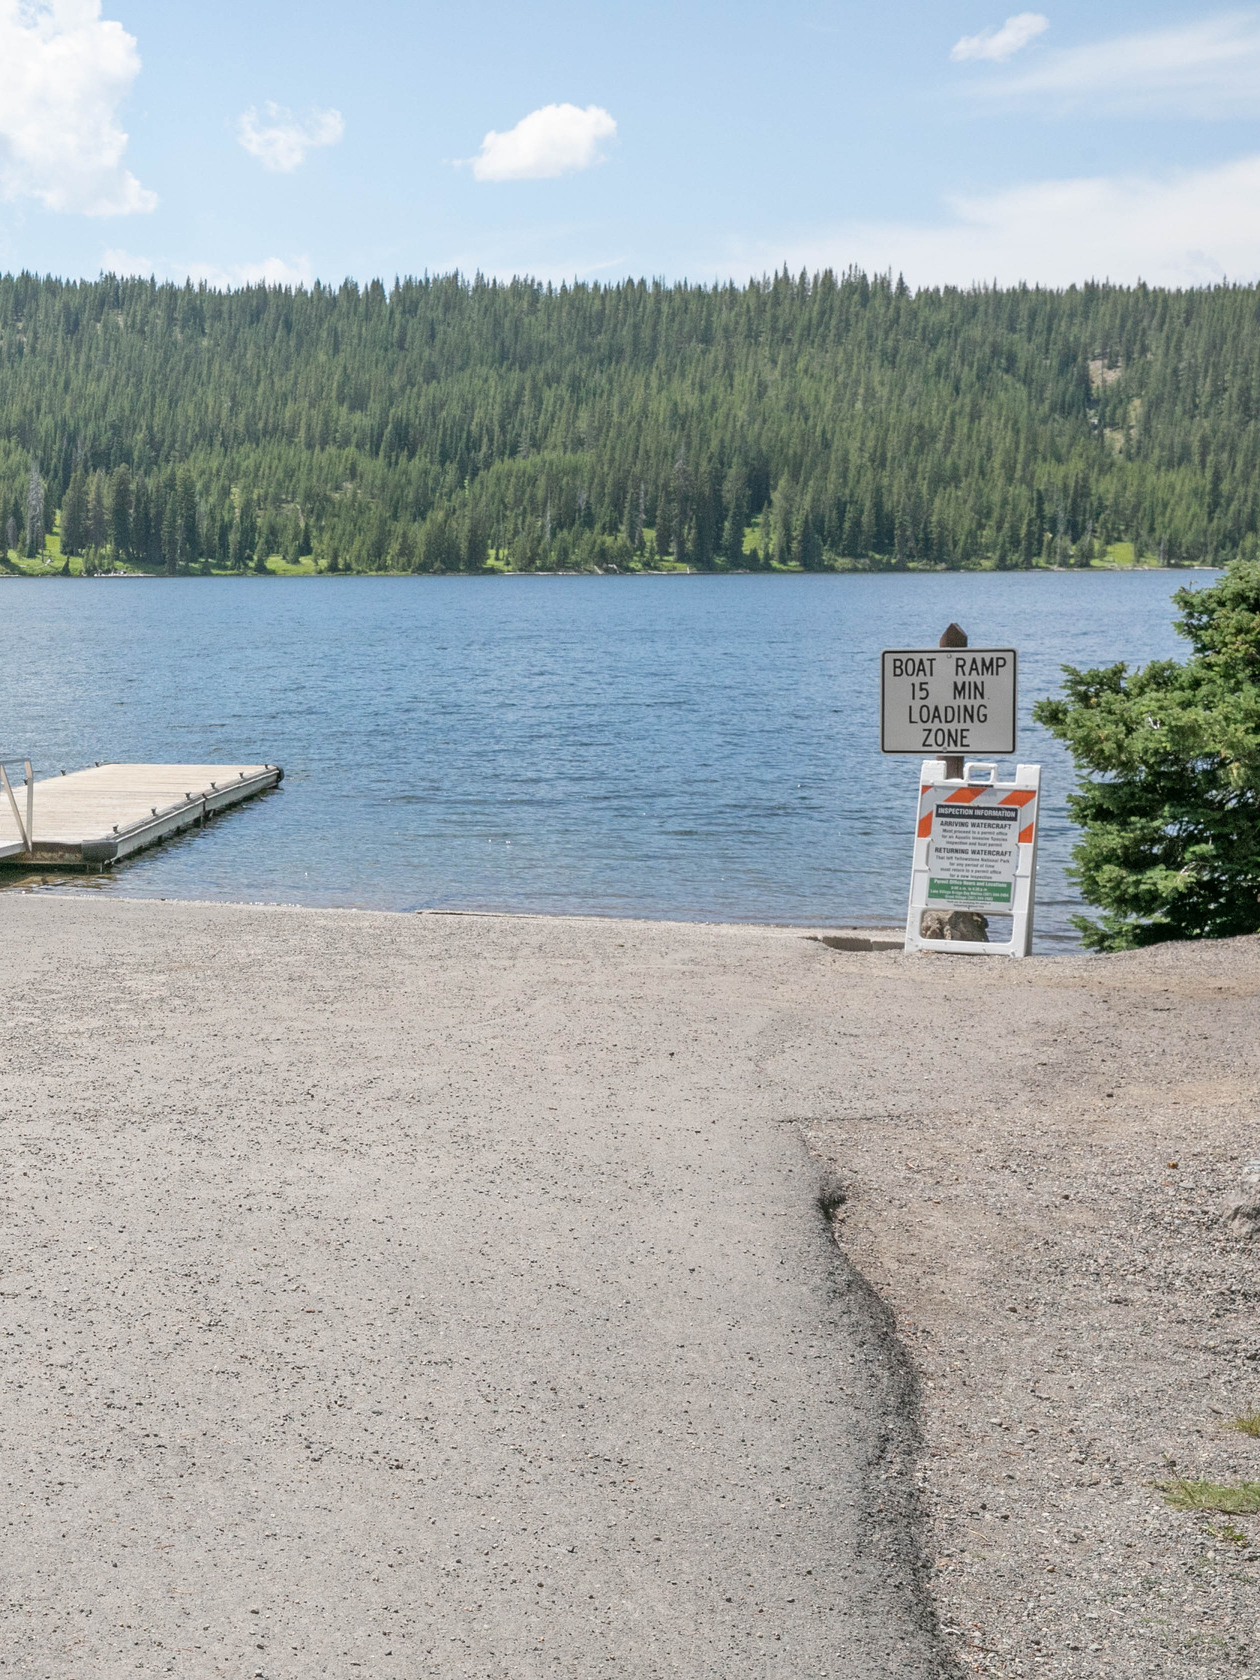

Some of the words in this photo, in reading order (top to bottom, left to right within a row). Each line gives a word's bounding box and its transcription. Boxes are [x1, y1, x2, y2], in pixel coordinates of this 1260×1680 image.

[893, 658, 936, 677] BOAT
[955, 657, 1007, 676] RAMP
[911, 682, 929, 700] 15
[909, 704, 988, 724] LOADING
[922, 728, 970, 747] ZONE
[938, 807, 974, 816] INSPECTION
[974, 809, 1016, 818] INFORMATION
[940, 820, 969, 828] ARRIVING
[971, 822, 1012, 830] WATERCRAFT
[934, 847, 969, 855] RETURNING
[970, 849, 1012, 857] WATERCRAFT
